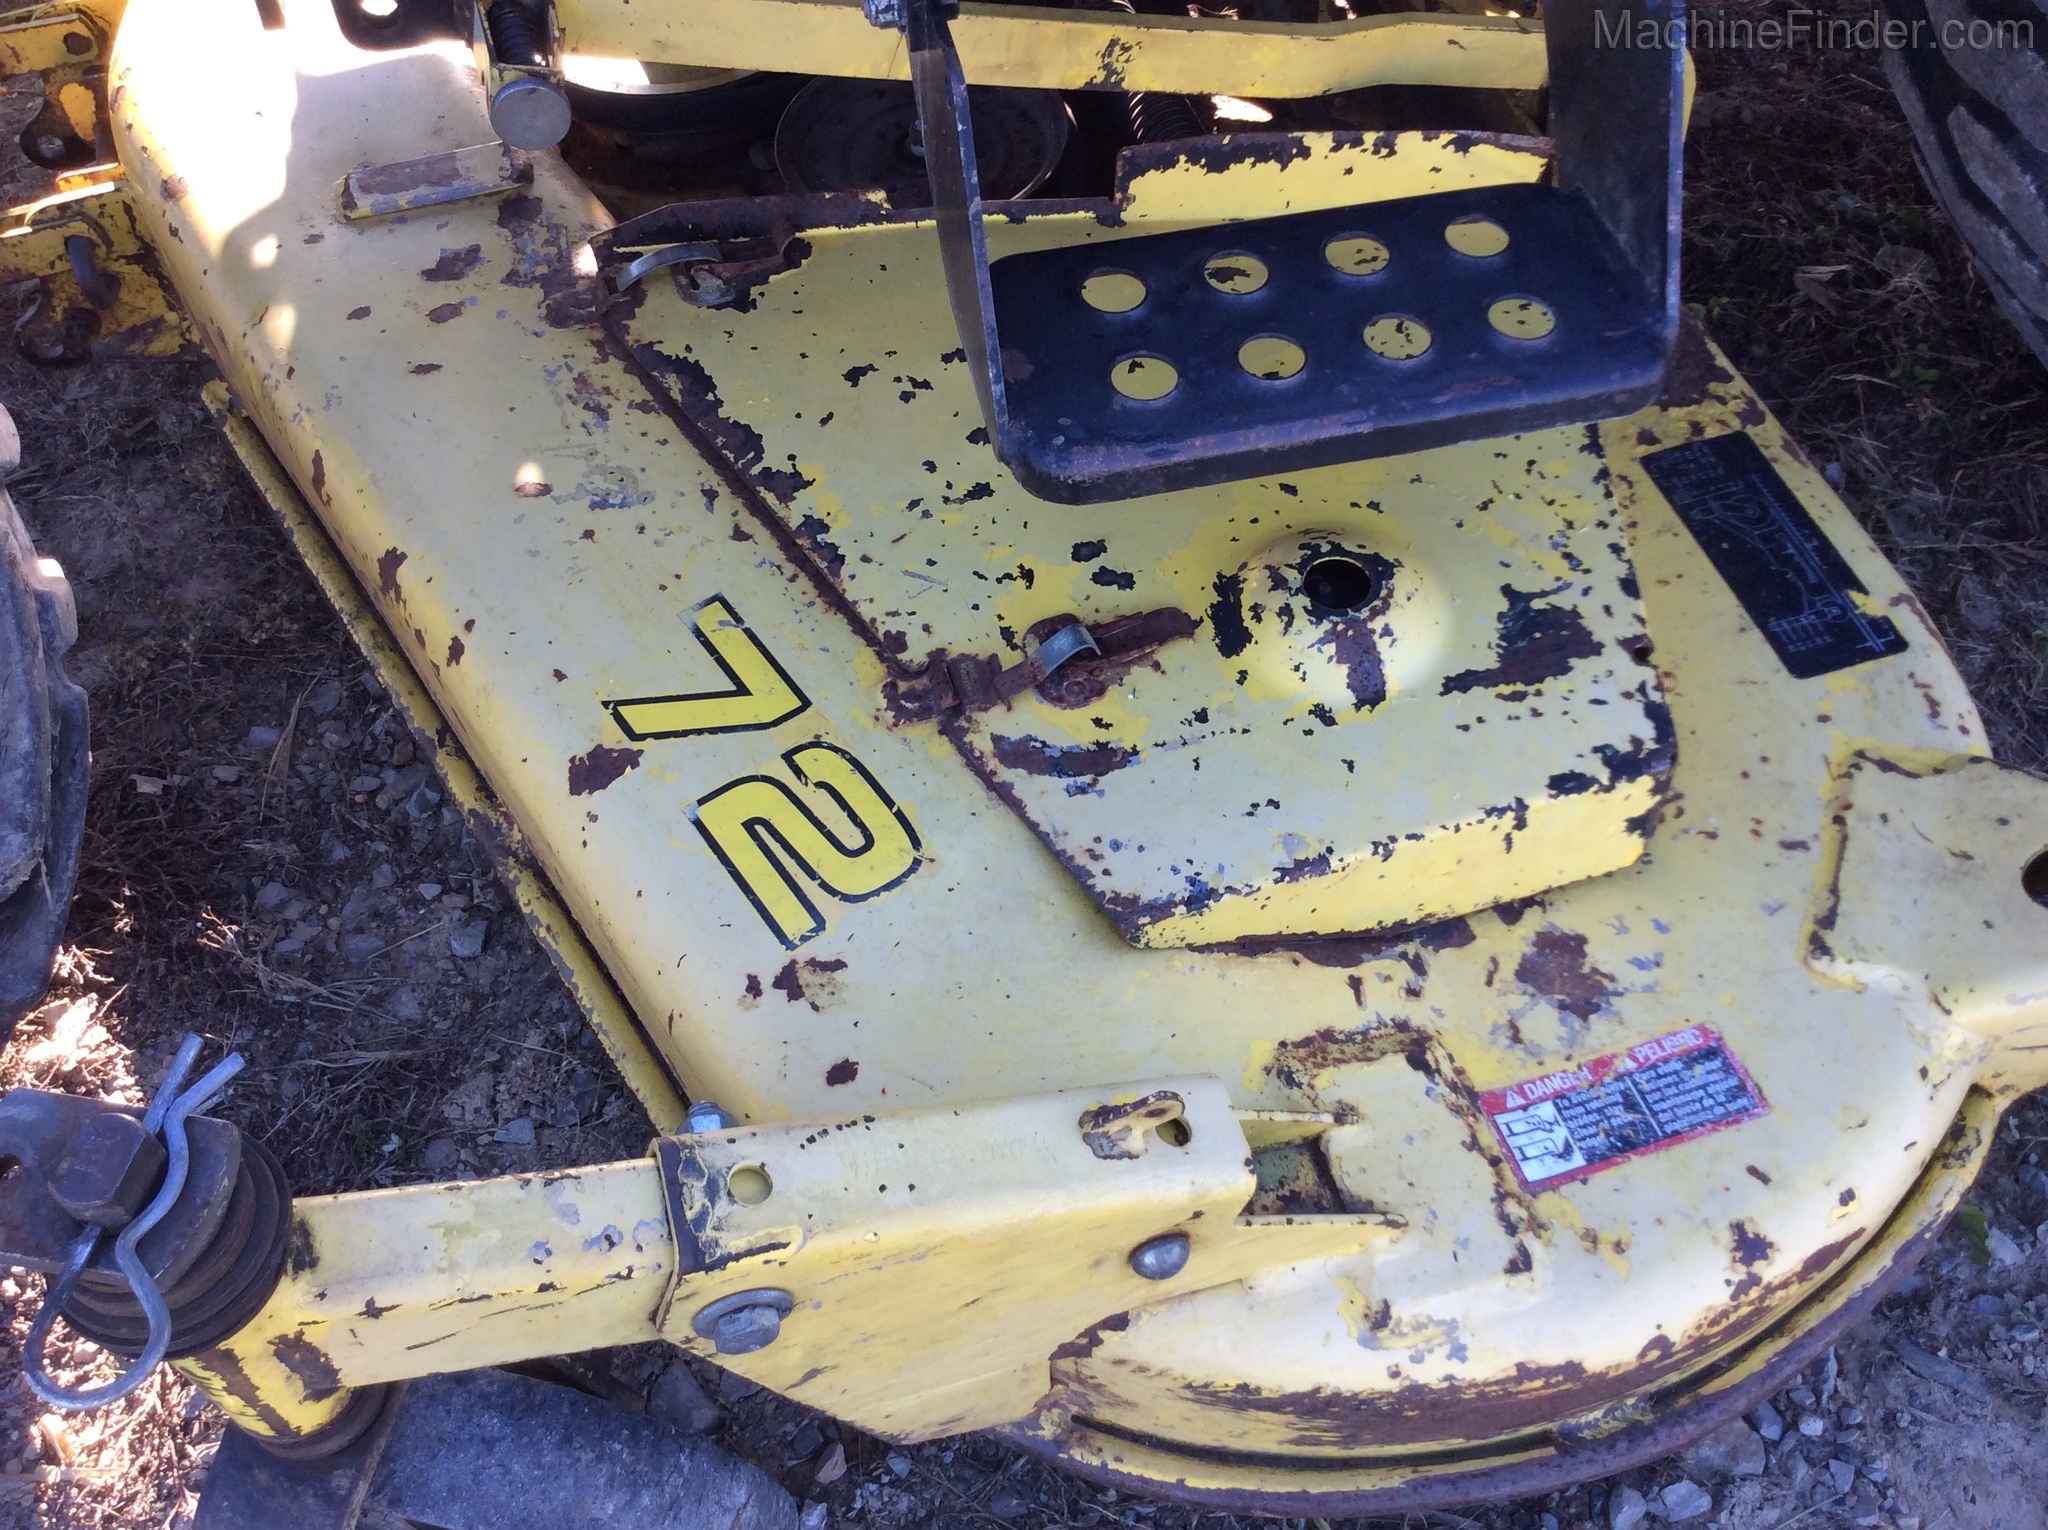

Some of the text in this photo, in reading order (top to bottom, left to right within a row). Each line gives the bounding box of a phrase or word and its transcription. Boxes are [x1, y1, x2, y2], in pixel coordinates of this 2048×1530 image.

[601, 591, 923, 951] 72
[1555, 1097, 1569, 1107] To
[1578, 1133, 1608, 1150] edg
